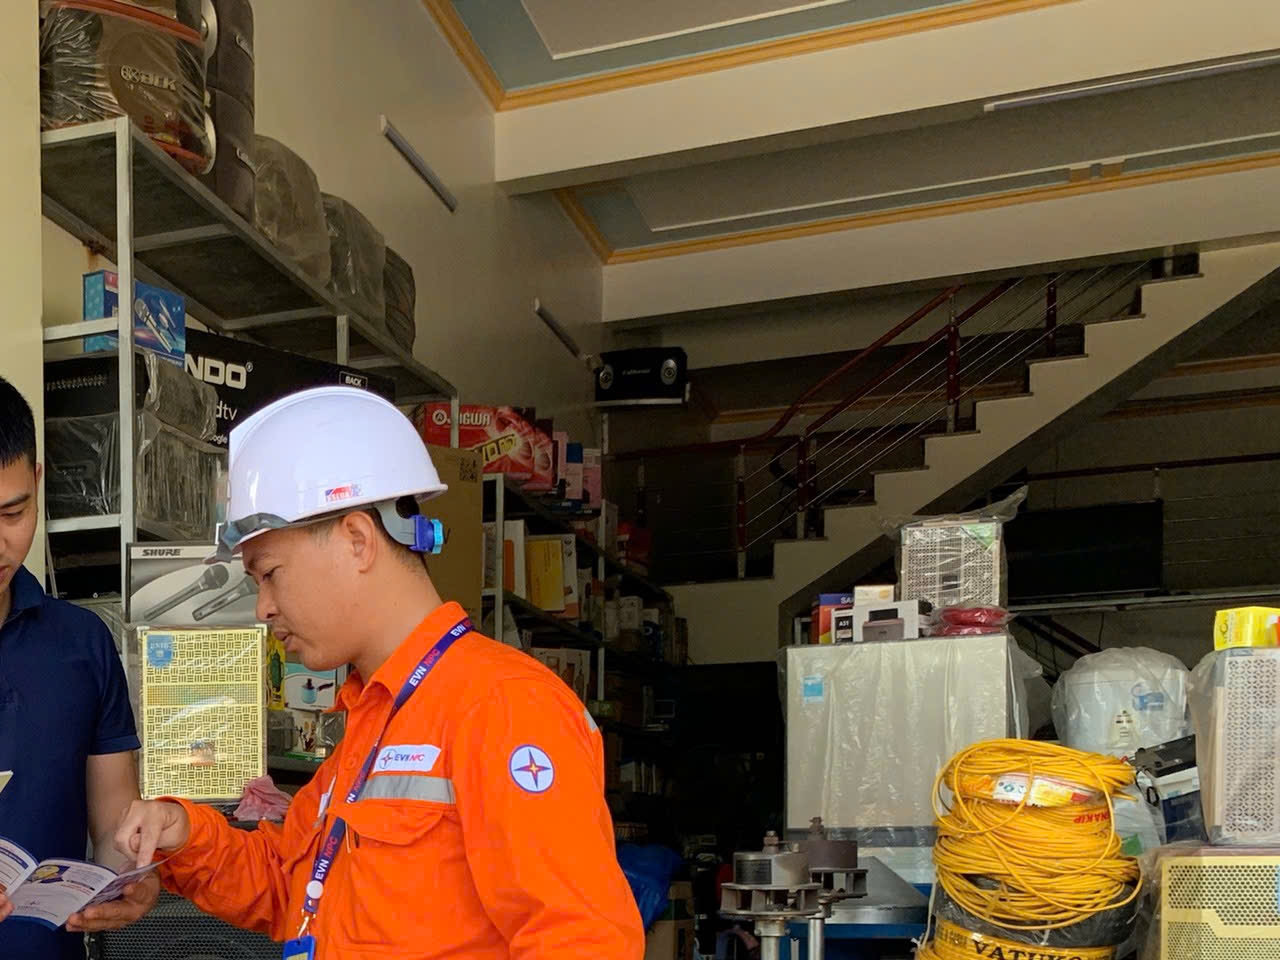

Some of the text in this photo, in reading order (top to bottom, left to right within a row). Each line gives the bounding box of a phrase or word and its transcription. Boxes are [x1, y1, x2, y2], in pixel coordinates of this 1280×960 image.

[345, 375, 362, 388] BACK
[142, 548, 181, 557] SHURE
[409, 666, 426, 687] EVN
[315, 836, 338, 880] EVN NPC
